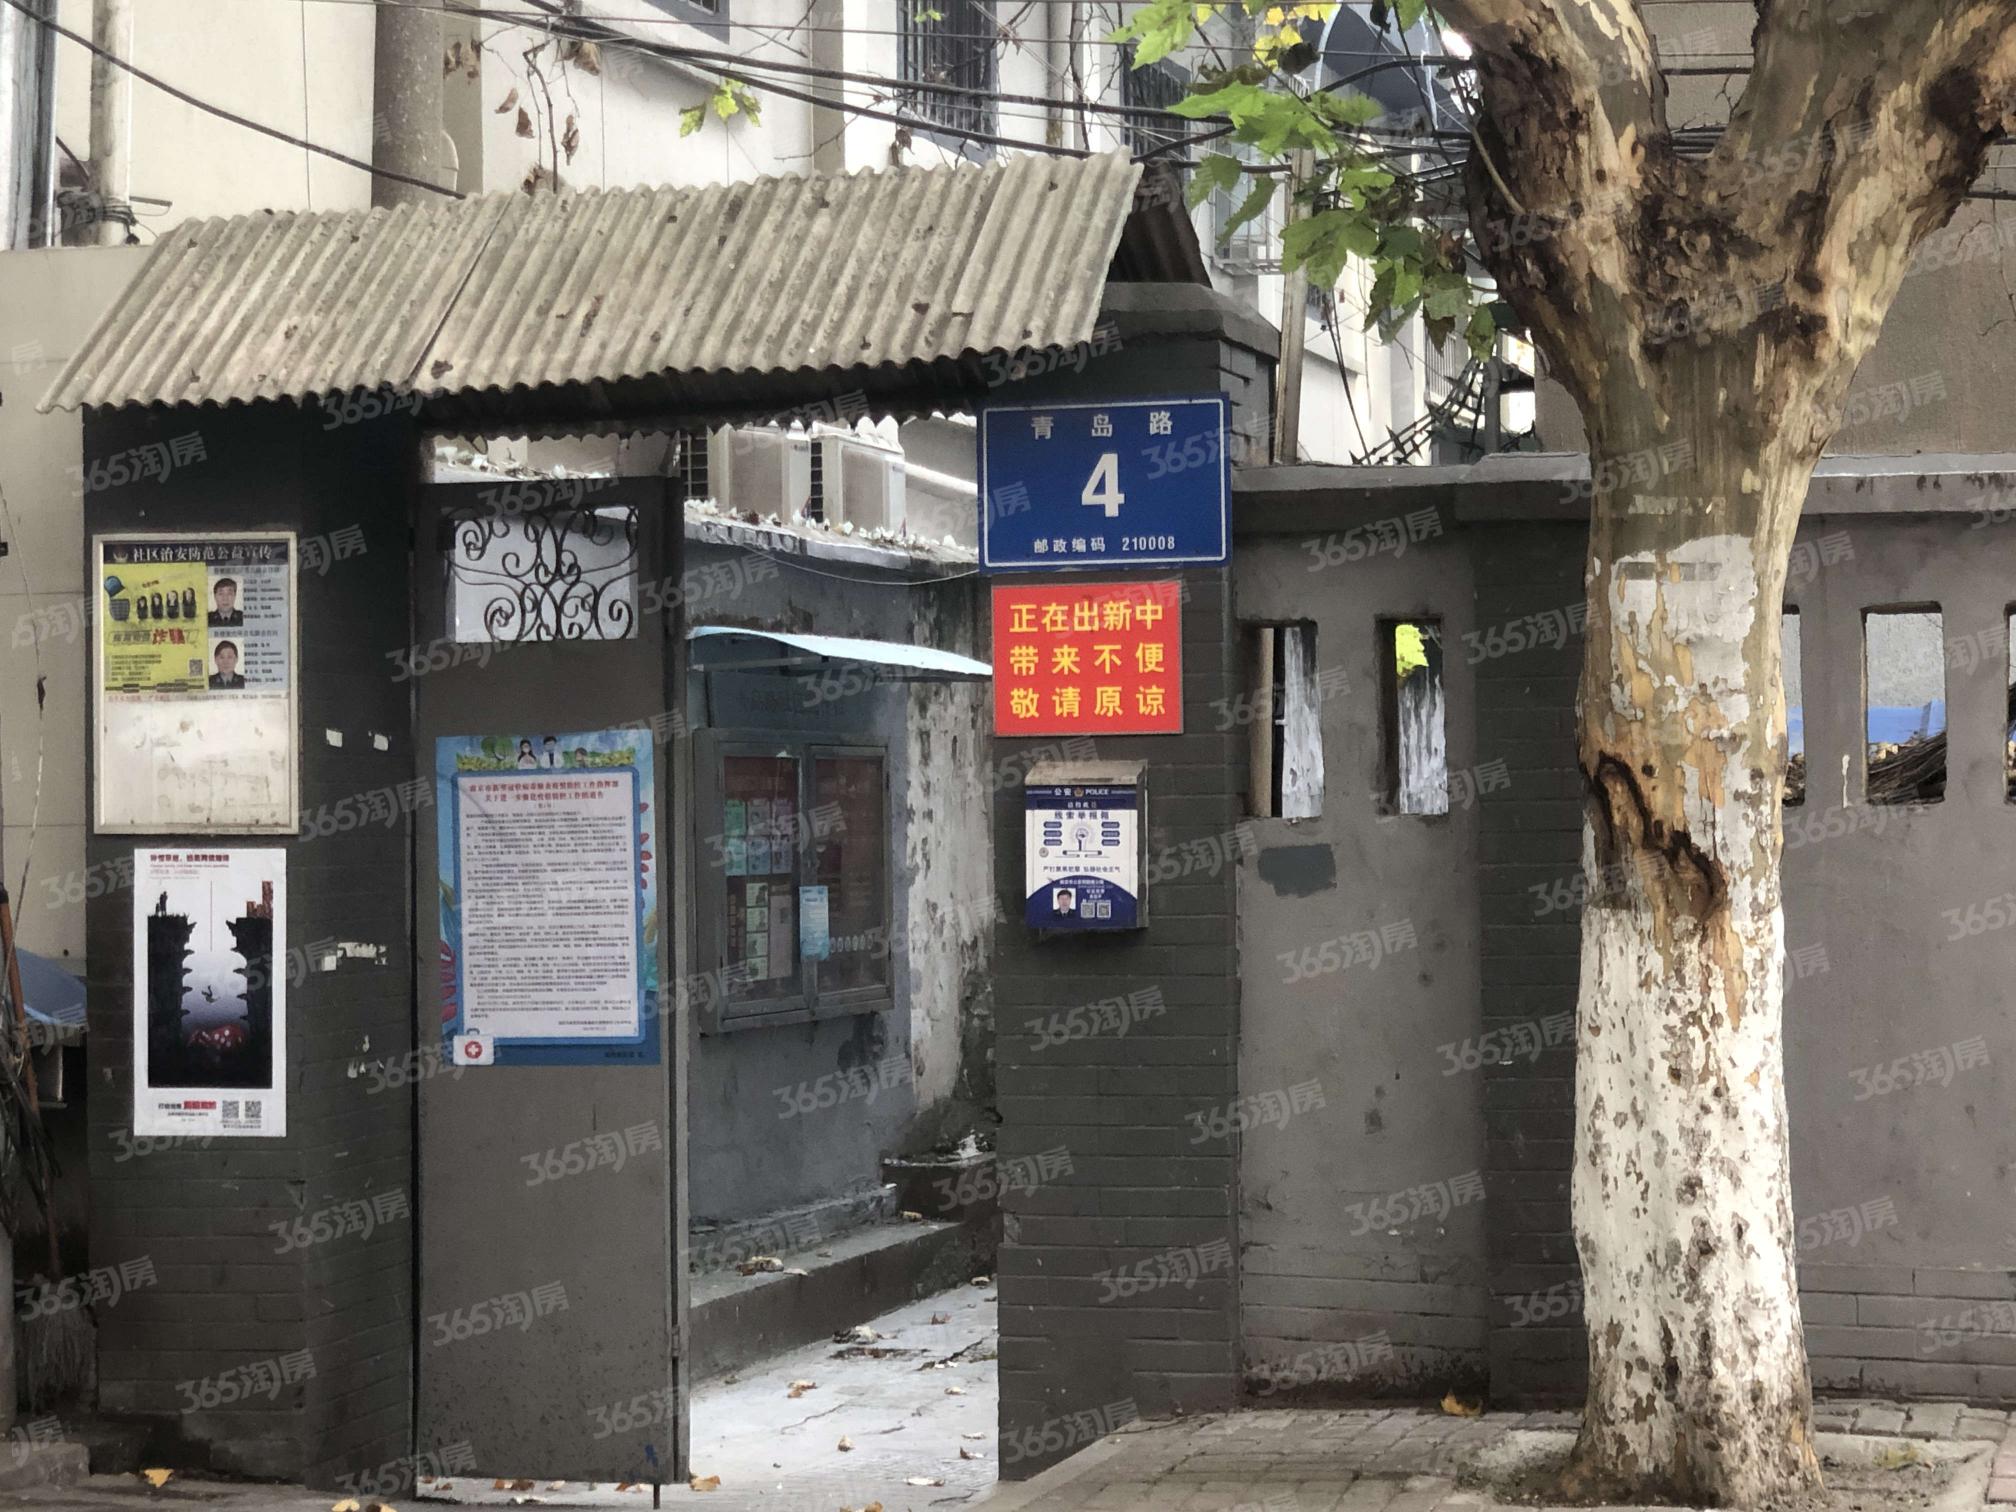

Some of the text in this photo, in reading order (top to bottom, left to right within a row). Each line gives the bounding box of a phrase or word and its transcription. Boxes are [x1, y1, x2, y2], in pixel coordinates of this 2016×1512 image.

[1030, 416, 1174, 439] 青岛路
[1081, 451, 1126, 518] 4
[132, 546, 273, 563] 社区治安防范公益宣传
[1033, 536, 1176, 553] 邮政编码 210008
[1009, 599, 1164, 634] 正在出新中
[1009, 642, 1165, 677] 带来不便
[1009, 684, 1166, 719] 敬请原谅
[1054, 788, 1110, 796] 公安 POLICE
